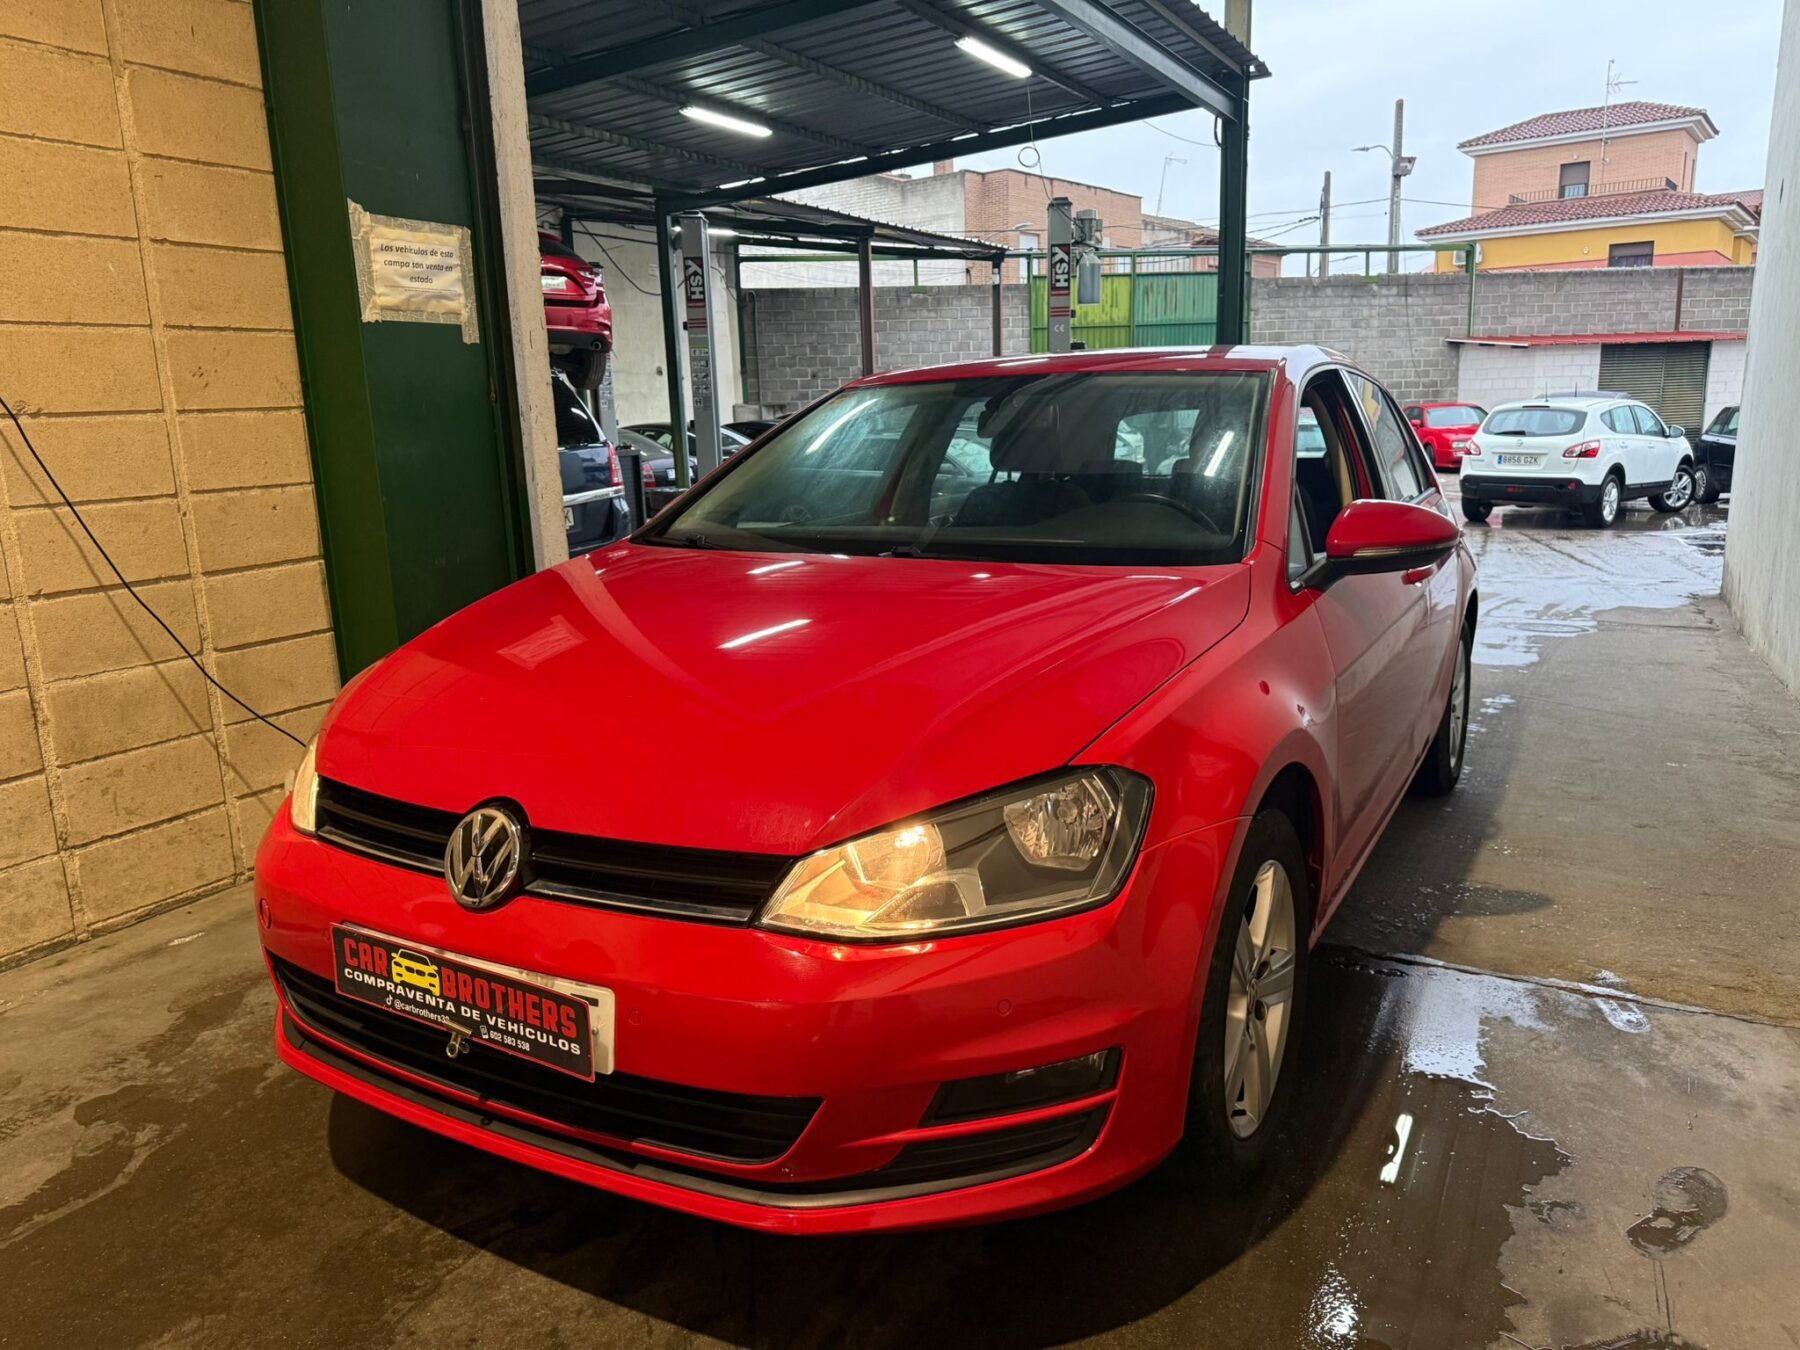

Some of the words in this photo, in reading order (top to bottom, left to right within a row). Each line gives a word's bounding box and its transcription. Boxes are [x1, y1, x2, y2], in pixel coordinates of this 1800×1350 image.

[380, 244, 393, 252] Los
[430, 249, 438, 257] de
[383, 259, 410, 269] campa
[425, 263, 443, 271] venta
[1052, 247, 1069, 287] HSY
[409, 275, 433, 284] estado
[685, 259, 704, 299] HSY
[1523, 456, 1539, 465] GZK
[343, 937, 388, 978] CAR
[441, 966, 577, 1039] BROTHERS
[344, 968, 455, 1013] COMPRAVENTA
[460, 1005, 481, 1022] DE
[487, 1014, 581, 1056] VEHÍCULOS
[489, 1030, 502, 1042] 602
[503, 1034, 516, 1046] 583
[517, 1039, 530, 1051] 538
